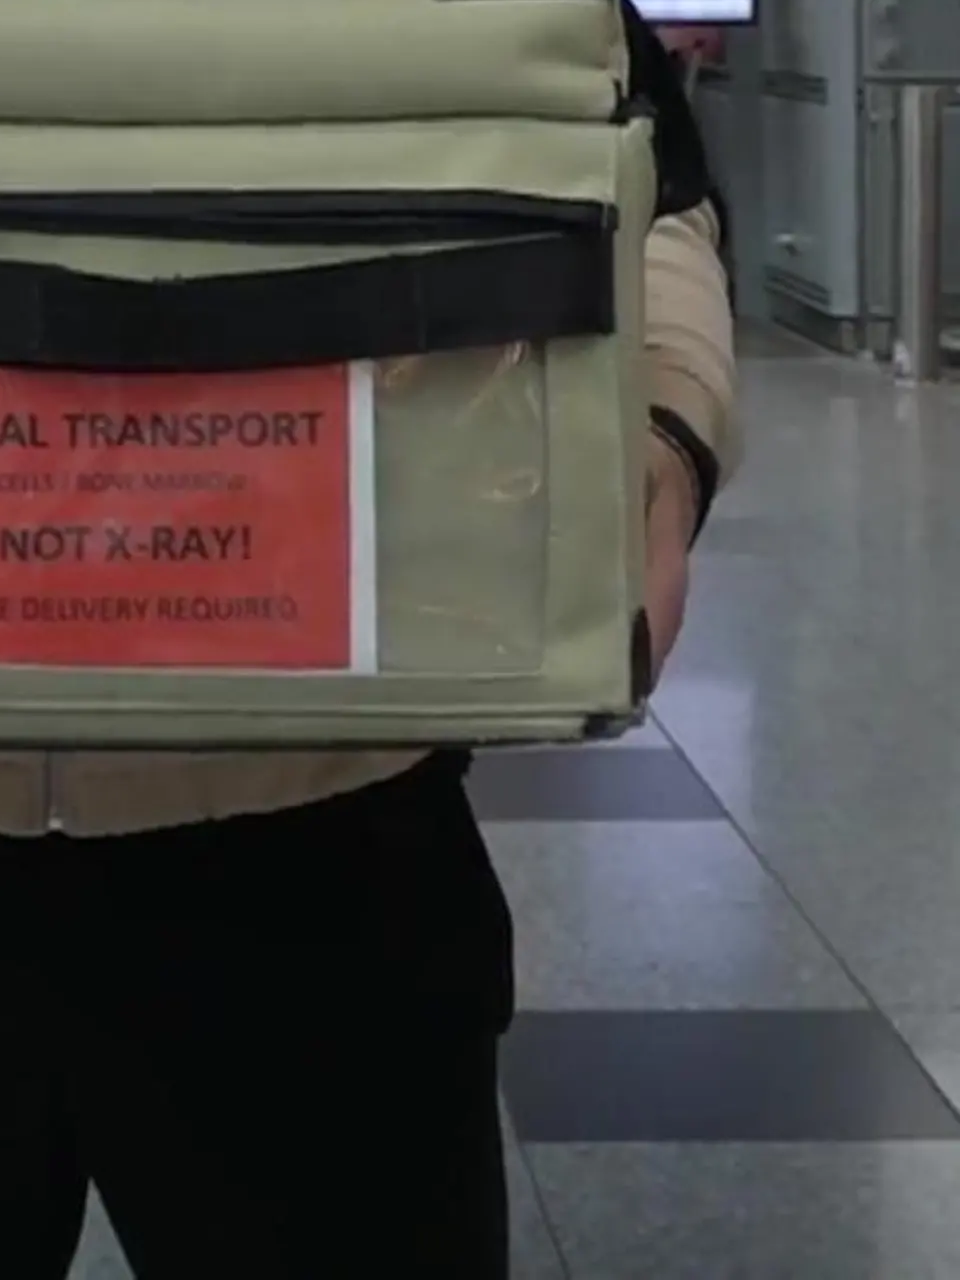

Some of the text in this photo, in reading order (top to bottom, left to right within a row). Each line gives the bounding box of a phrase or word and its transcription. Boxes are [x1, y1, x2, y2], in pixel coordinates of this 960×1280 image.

[61, 411, 325, 447] TRANSPORT
[0, 525, 90, 561] NOT
[105, 525, 252, 560] X-RAY!
[22, 597, 148, 622] DELIVERY
[157, 596, 298, 622] REQUIRED
